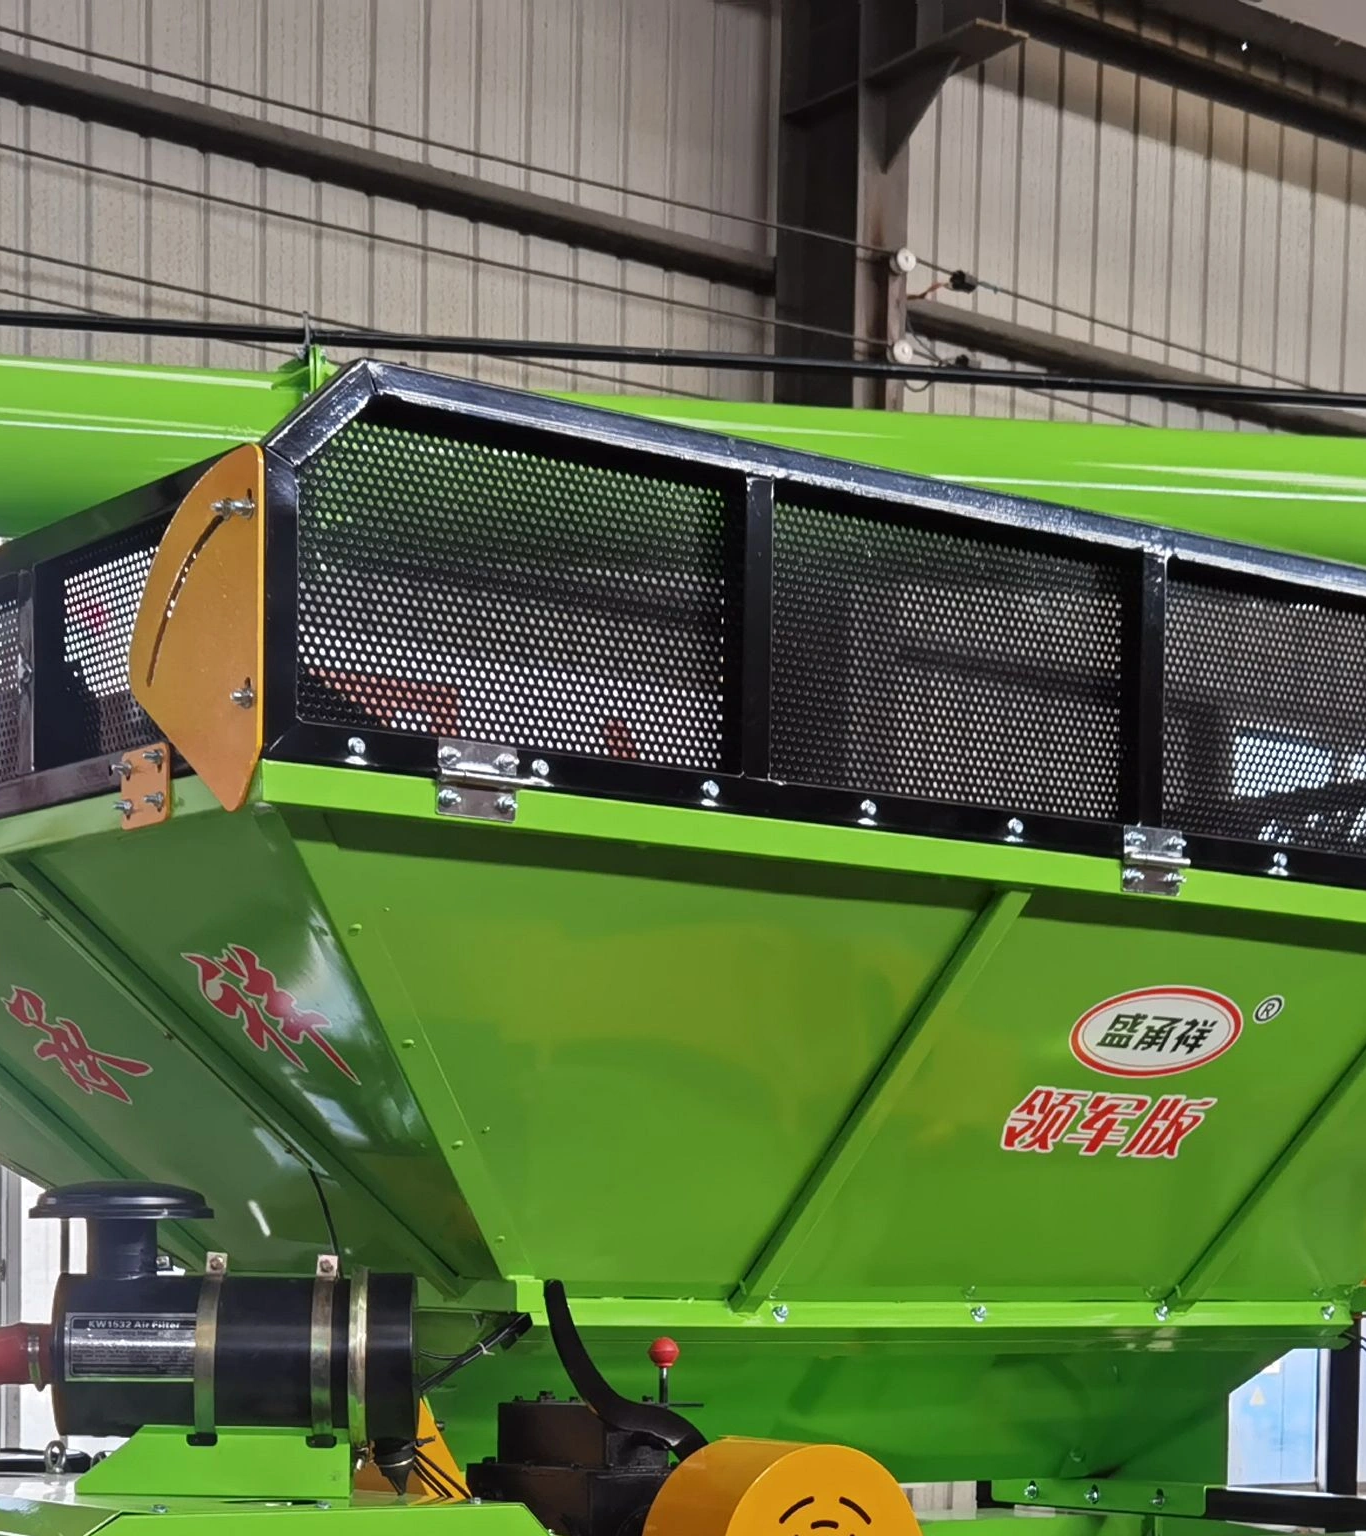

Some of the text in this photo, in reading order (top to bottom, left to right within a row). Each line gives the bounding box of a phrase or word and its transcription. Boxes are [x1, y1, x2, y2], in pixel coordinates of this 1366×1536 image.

[1001, 1086, 1217, 1158] 领军版
[134, 1320, 150, 1329] Air
